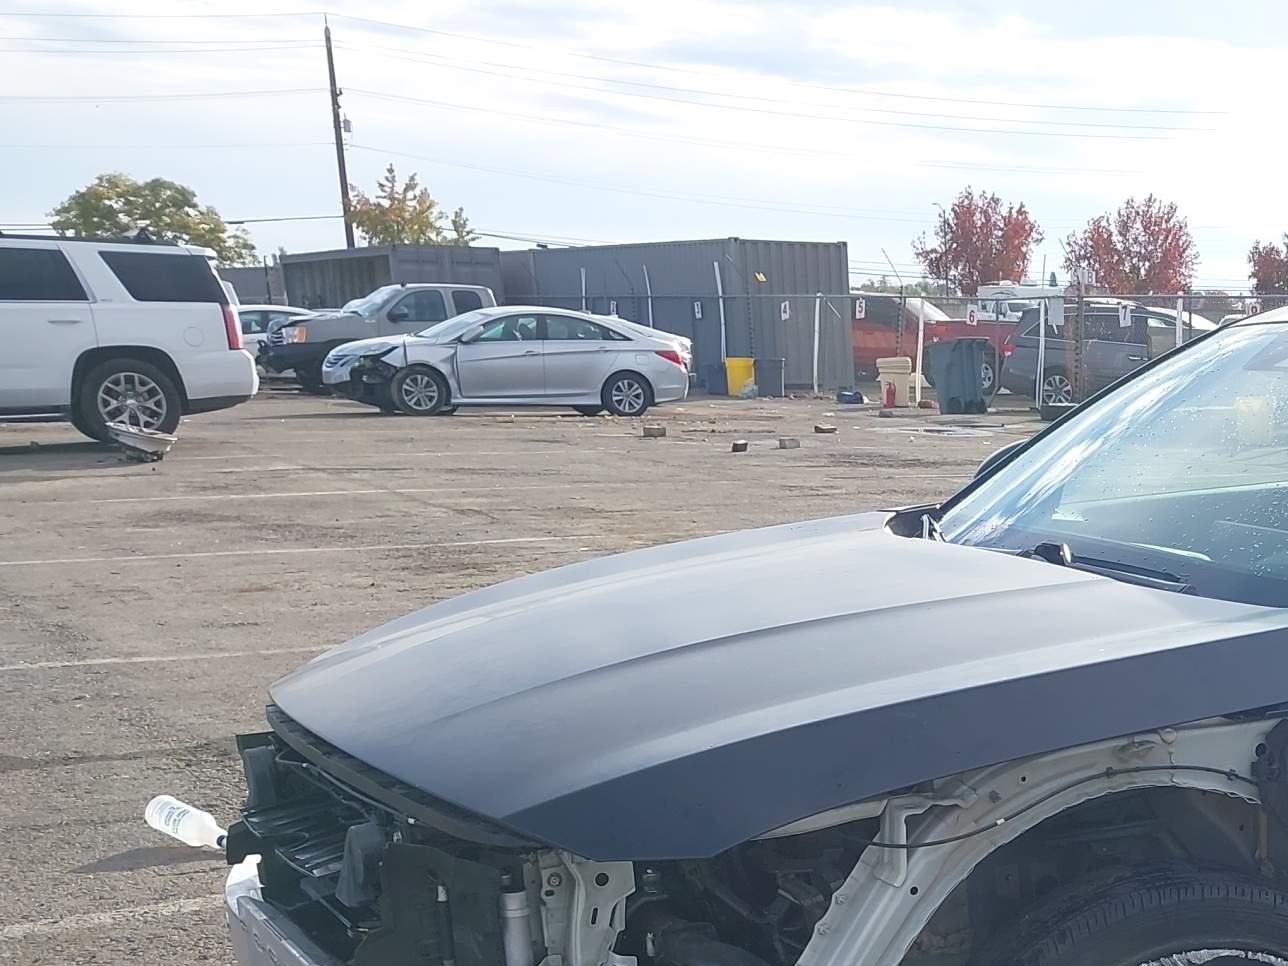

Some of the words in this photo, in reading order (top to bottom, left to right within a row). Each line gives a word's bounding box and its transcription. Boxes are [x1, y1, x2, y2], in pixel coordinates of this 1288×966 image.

[858, 302, 863, 313] 5
[1121, 305, 1127, 320] 7
[969, 309, 975, 323] 6
